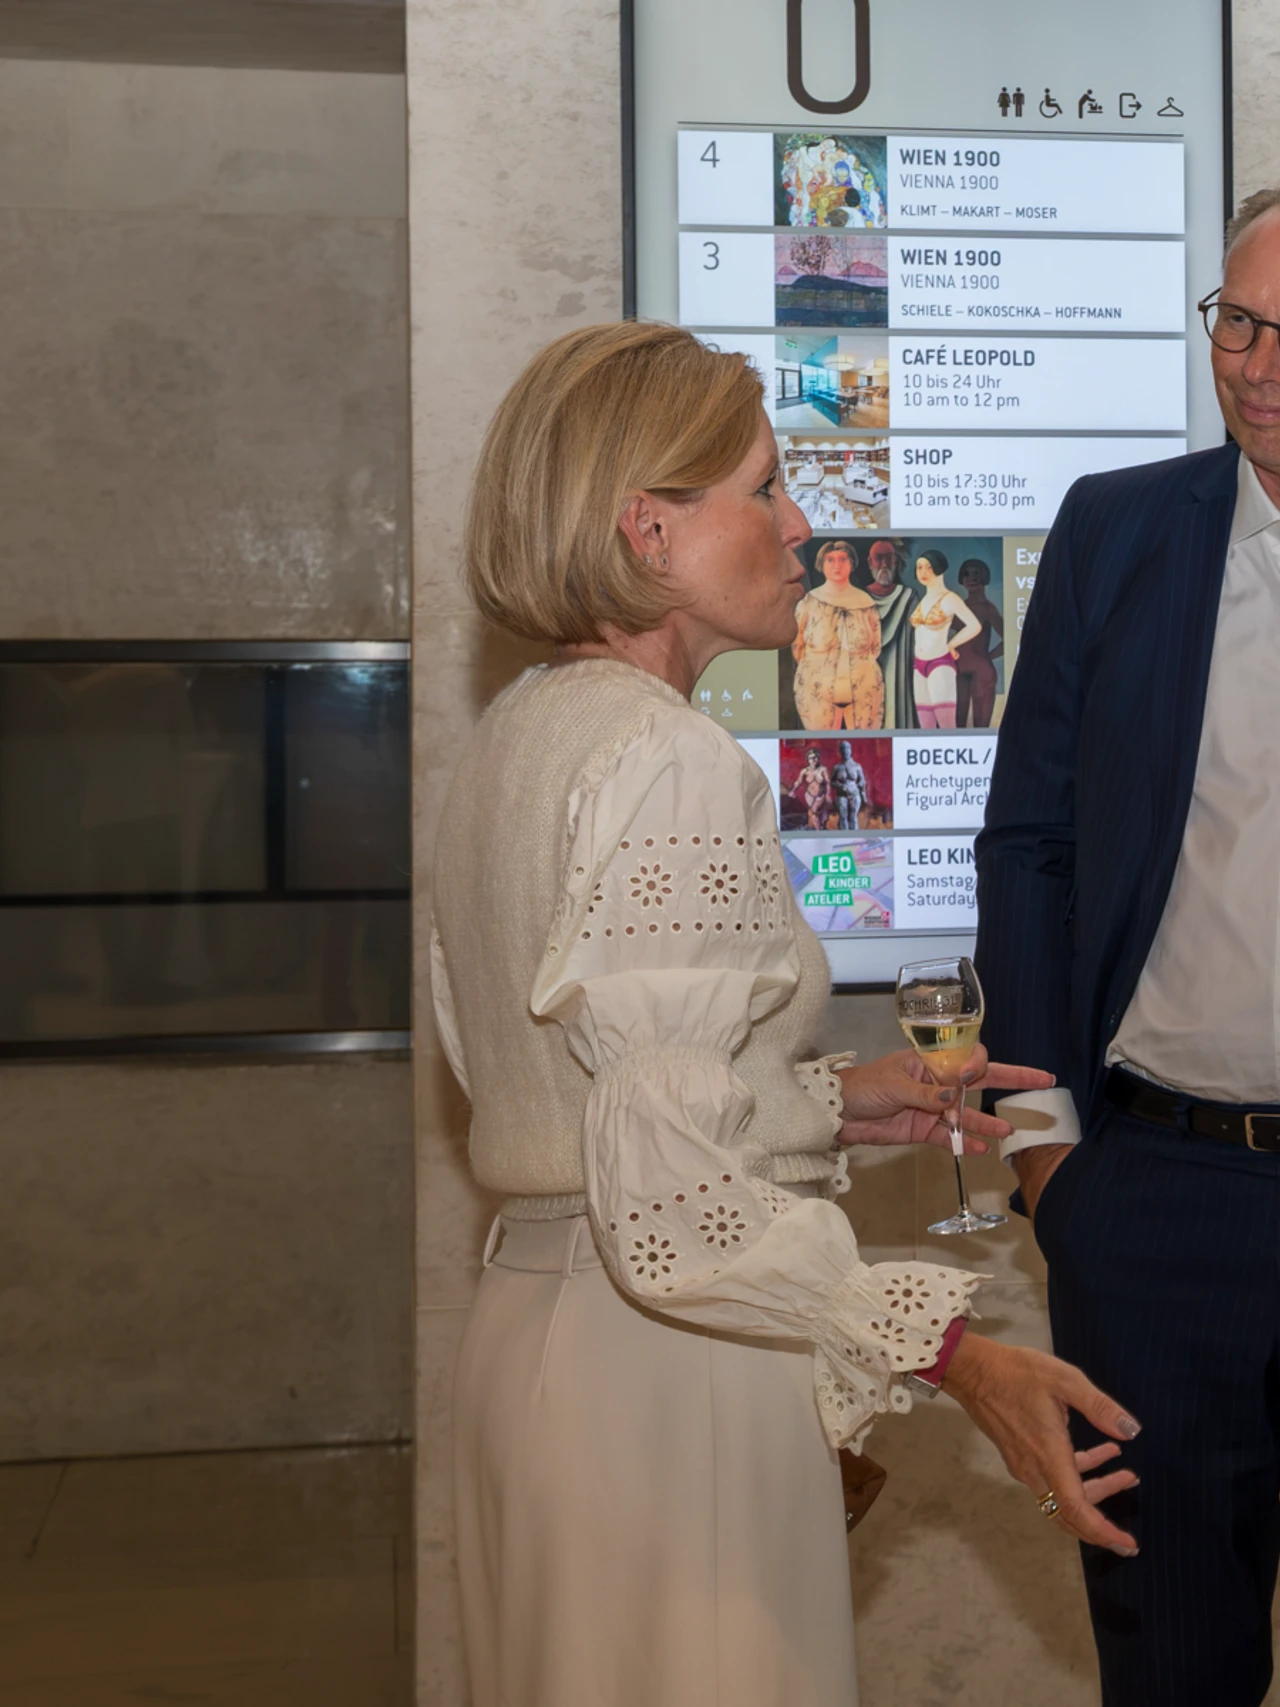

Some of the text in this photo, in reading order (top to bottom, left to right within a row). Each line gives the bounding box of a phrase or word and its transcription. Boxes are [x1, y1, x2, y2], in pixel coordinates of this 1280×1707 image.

[700, 141, 720, 168] 4
[900, 149, 1000, 167] WIEN 1900
[900, 174, 998, 190] VIENNA 1900
[901, 205, 936, 216] KLIMT
[953, 206, 1000, 217] MAKART
[1016, 207, 1057, 219] MOSER
[703, 242, 719, 270] 3
[901, 249, 1001, 266] WIEN 1900
[901, 274, 999, 289] VIENNA 1900
[902, 304, 952, 316] SCHIELE
[968, 305, 1040, 317] KOKOSCHKA
[1056, 307, 1121, 318] HOFFMANN
[903, 345, 1035, 366] CAFÉ LEOPOLD
[904, 374, 1002, 389] 10 bis 24 Uhr
[904, 392, 1019, 410] 10 am to 12 pm
[904, 449, 952, 465] SHOP
[905, 474, 1027, 488] 10 bis 17:30 Uhr
[905, 492, 1035, 510] 10 am to 5.30 pm
[907, 748, 991, 765] BOECKL /
[907, 792, 958, 811] Figural
[818, 856, 851, 873] LEO
[908, 848, 941, 865] LEO
[829, 877, 869, 889] KINDER
[807, 893, 850, 905] ATELIER
[898, 995, 957, 1012] OCHRIGL
